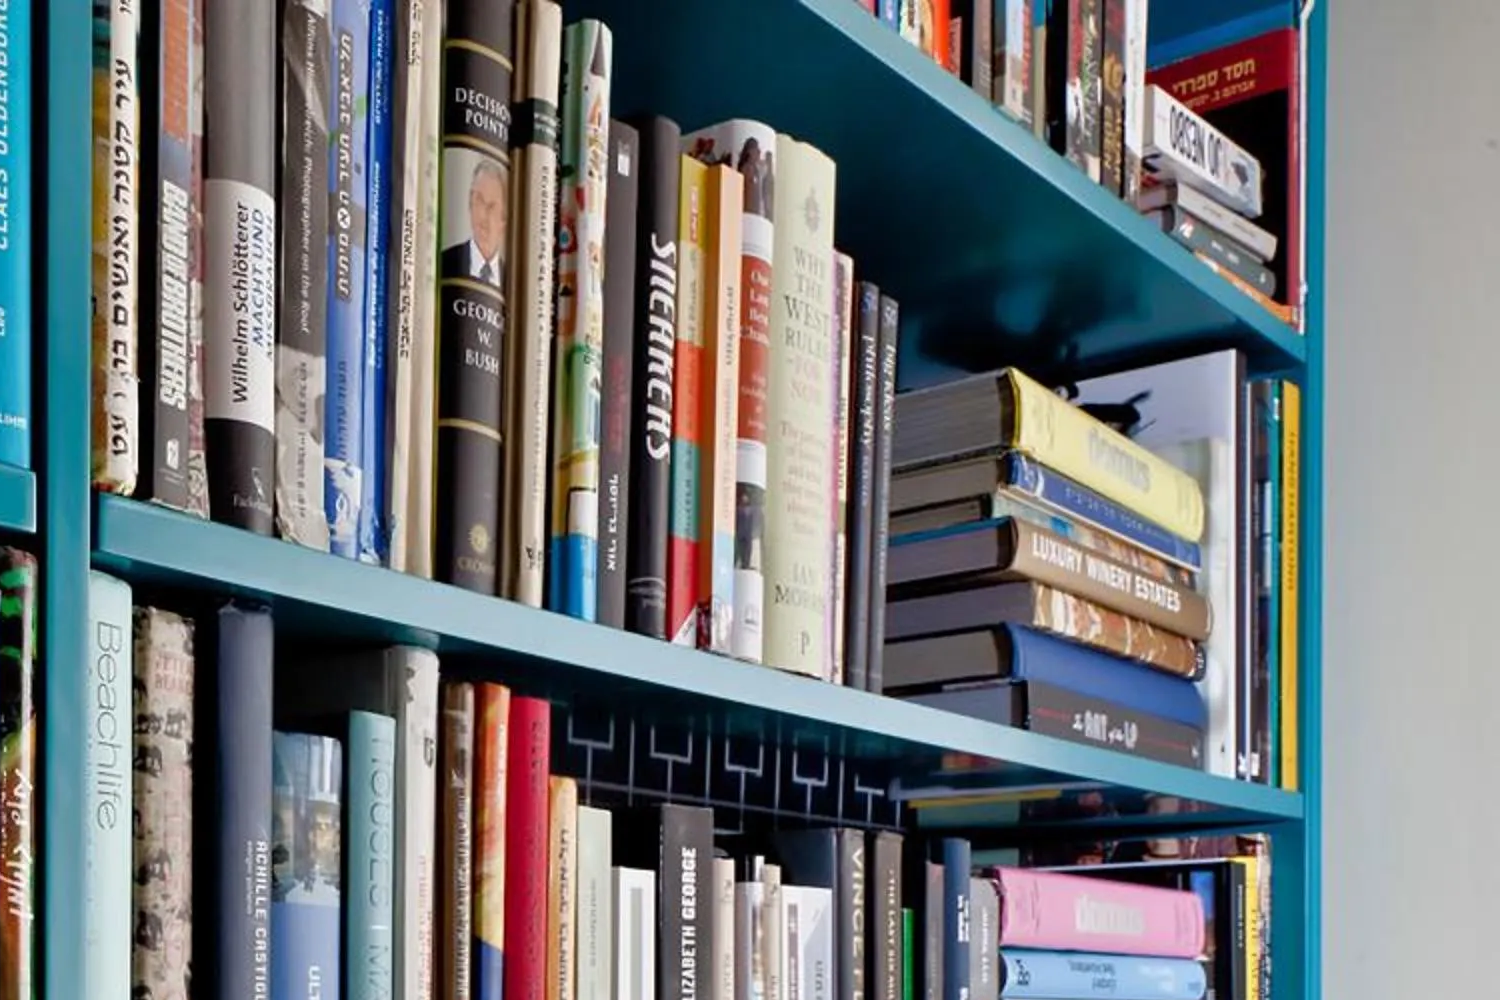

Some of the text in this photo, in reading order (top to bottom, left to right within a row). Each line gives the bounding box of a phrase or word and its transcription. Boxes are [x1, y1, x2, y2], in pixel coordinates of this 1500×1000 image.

[112, 58, 133, 108] עיר
[337, 33, 352, 125] תל-אביב
[1171, 57, 1257, 96] חסד ספרדי
[112, 118, 135, 206] קטנה
[336, 133, 352, 186] העיר
[161, 180, 189, 259] BAND
[109, 215, 131, 328] ואנשים
[230, 202, 250, 404] Wilhelm Schlötterer
[251, 208, 267, 348] MACHT UND
[159, 275, 188, 412] BROTHERS
[464, 348, 500, 376] BUSH
[645, 233, 678, 466] SNEAKERS
[1031, 531, 1181, 613] LUXURY WINERY ESTATES
[95, 620, 124, 832] Beachlife
[254, 840, 268, 920] ACHILLE
[680, 847, 698, 920] GEORGE
[851, 846, 866, 960] VINCE
